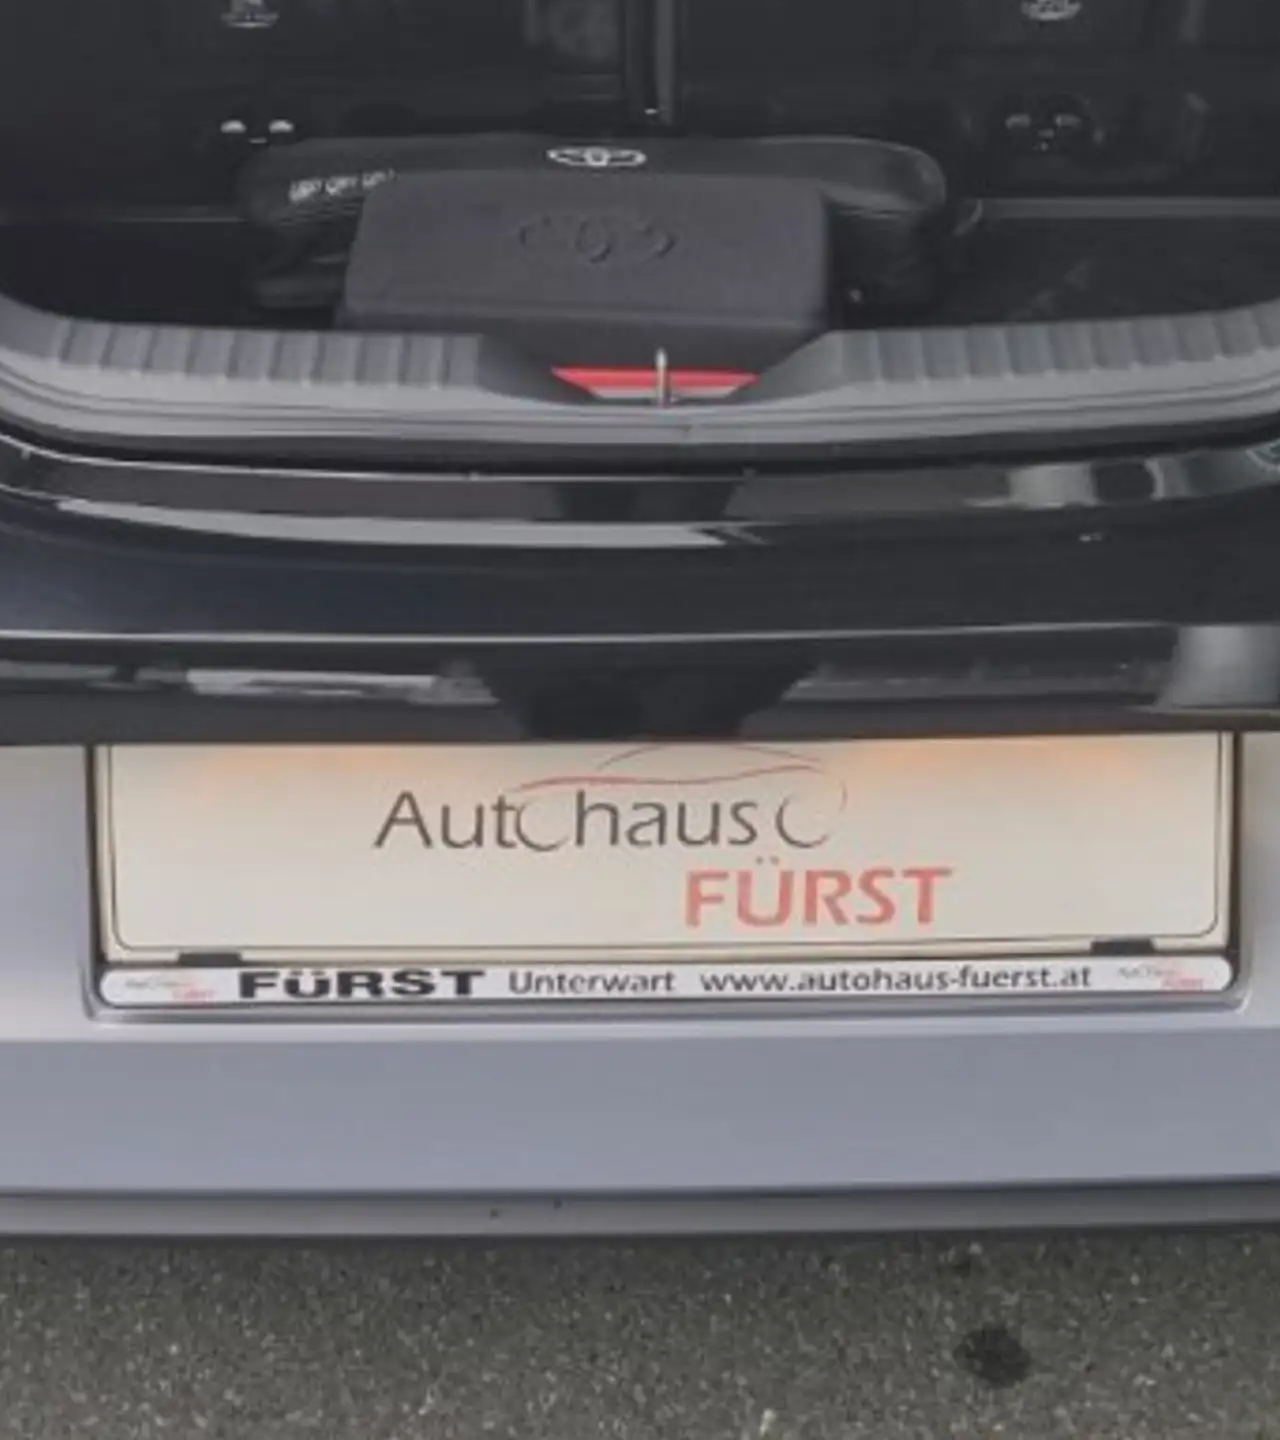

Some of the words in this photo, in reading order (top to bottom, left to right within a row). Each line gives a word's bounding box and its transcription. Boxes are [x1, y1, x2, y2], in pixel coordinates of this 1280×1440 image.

[372, 789, 757, 851] Autohaus
[683, 855, 953, 927] FÜRST
[239, 968, 486, 999] FÜRST
[508, 969, 676, 995] Unterwart
[698, 964, 1092, 992] www.autohaus-fuerst.at
